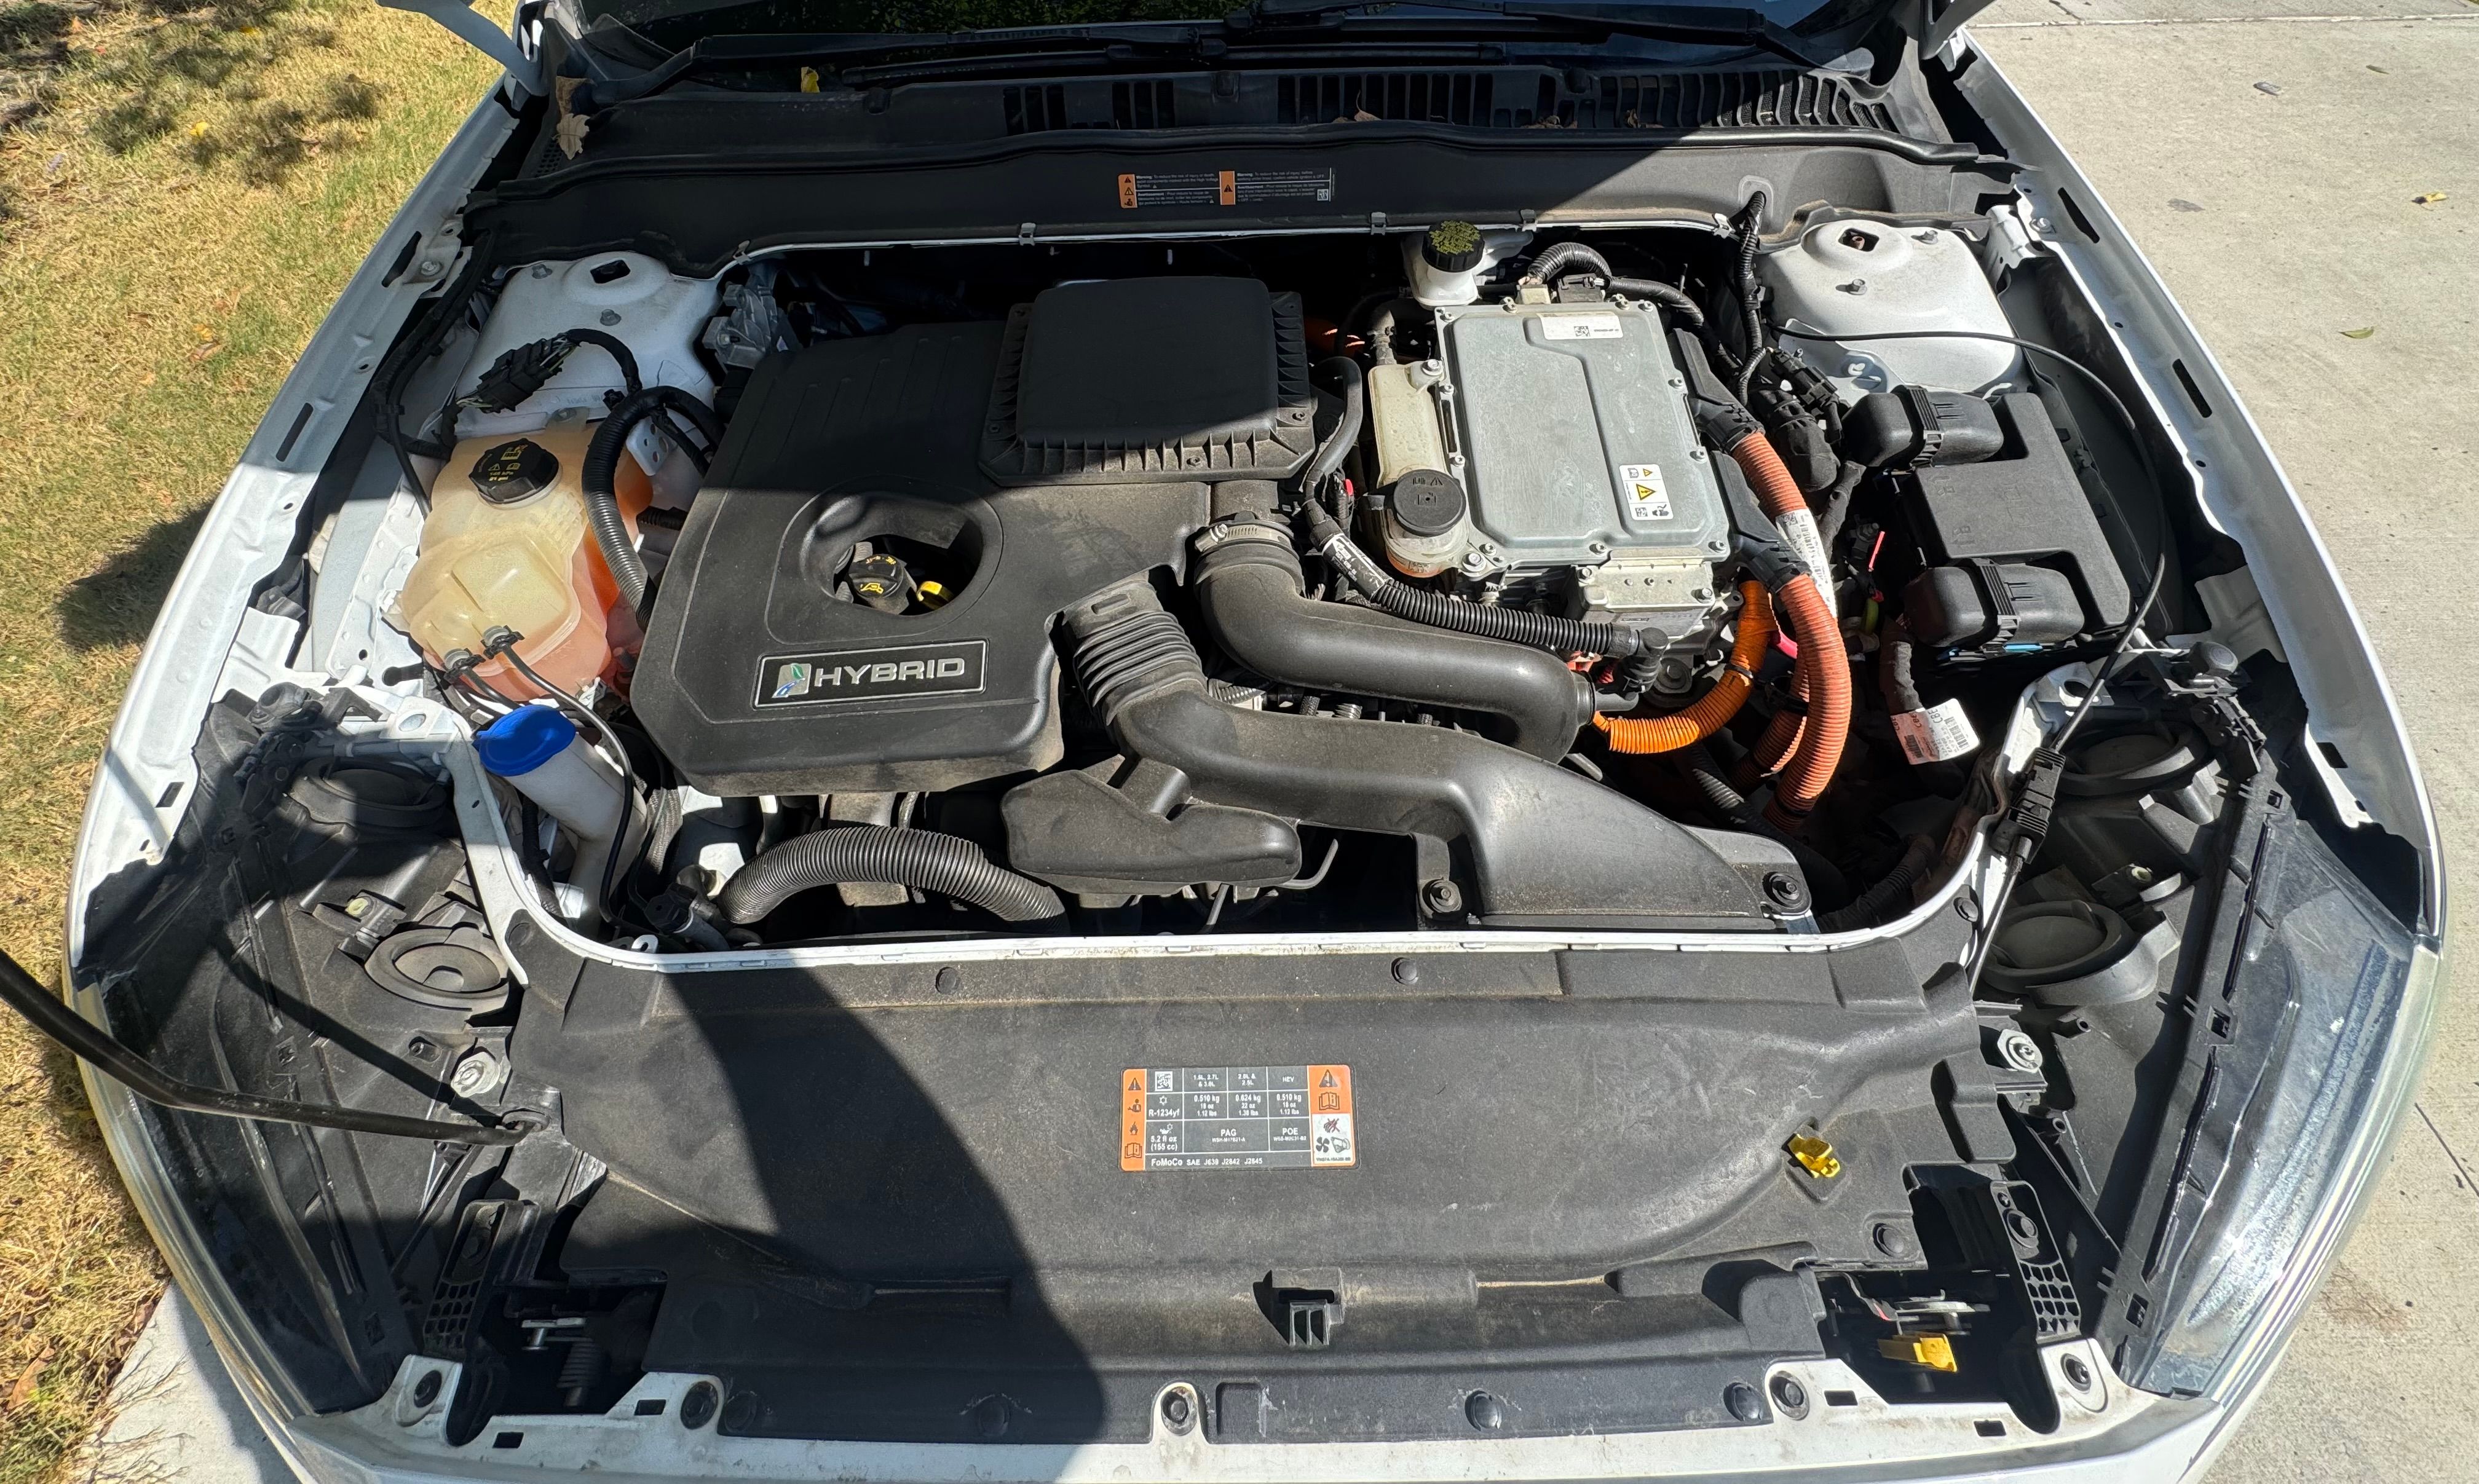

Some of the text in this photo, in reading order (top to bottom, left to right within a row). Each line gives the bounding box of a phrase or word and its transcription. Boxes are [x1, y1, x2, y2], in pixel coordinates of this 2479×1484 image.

[813, 658, 966, 687] HYBRID
[1927, 708, 1943, 724] CBE
[1212, 1095, 1220, 1103] kg
[1149, 1108, 1180, 1117] R-1234yf
